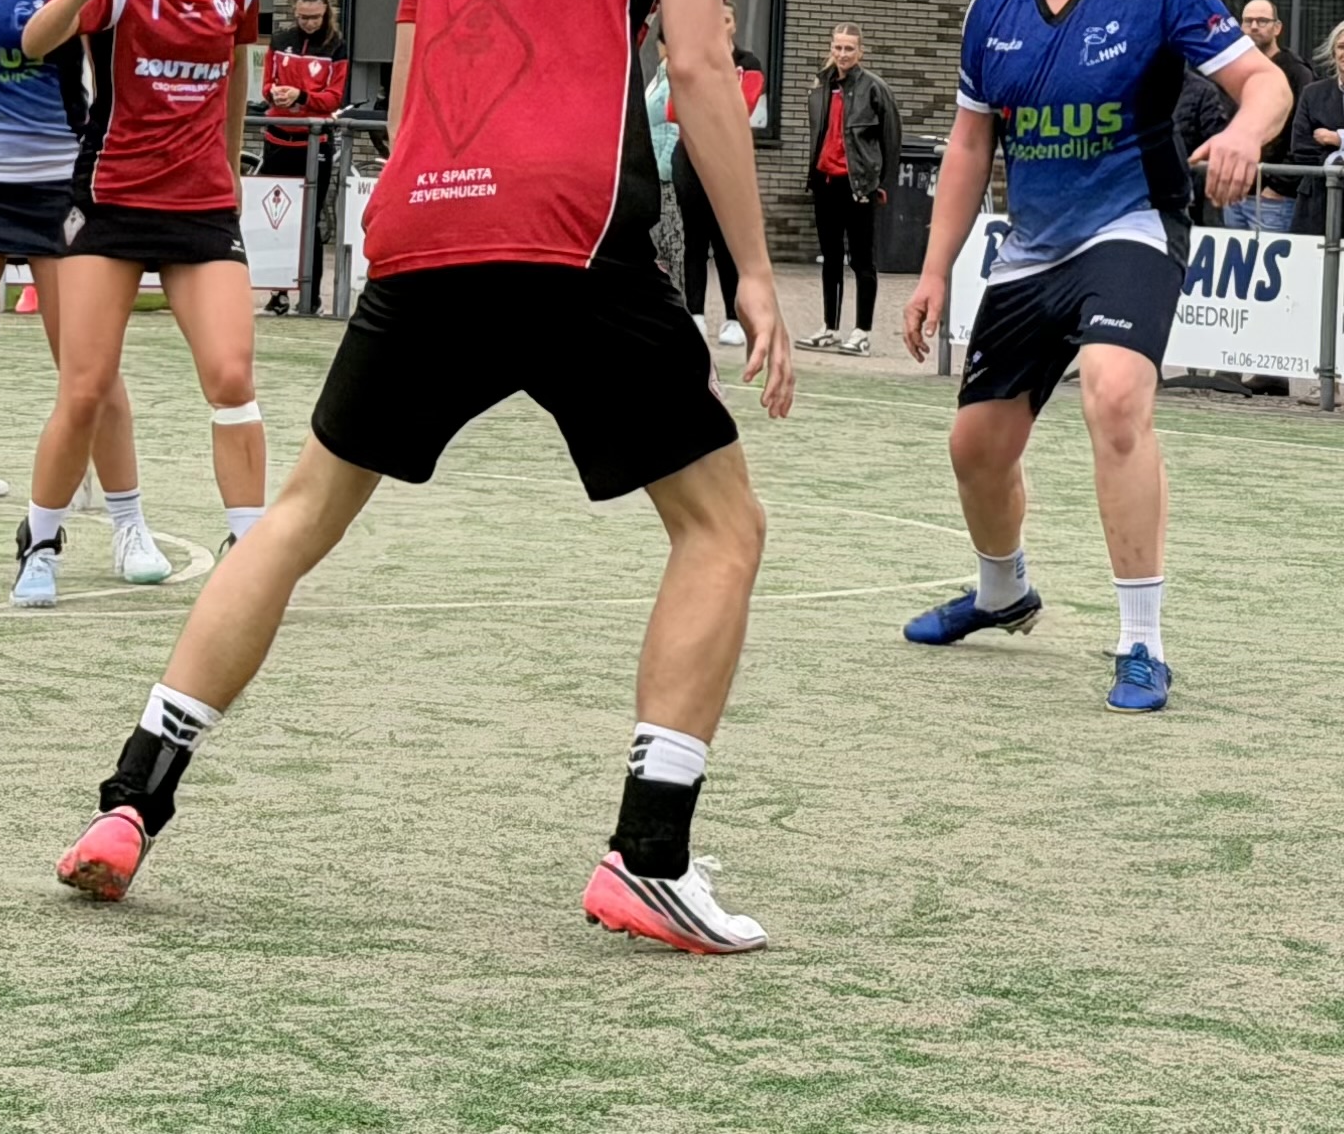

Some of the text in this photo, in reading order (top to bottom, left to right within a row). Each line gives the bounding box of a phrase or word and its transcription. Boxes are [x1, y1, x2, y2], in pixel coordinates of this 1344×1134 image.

[1016, 102, 1123, 137] PLUS
[442, 168, 493, 183] SPARTA
[409, 183, 497, 204] ZEVENHUIZEN
